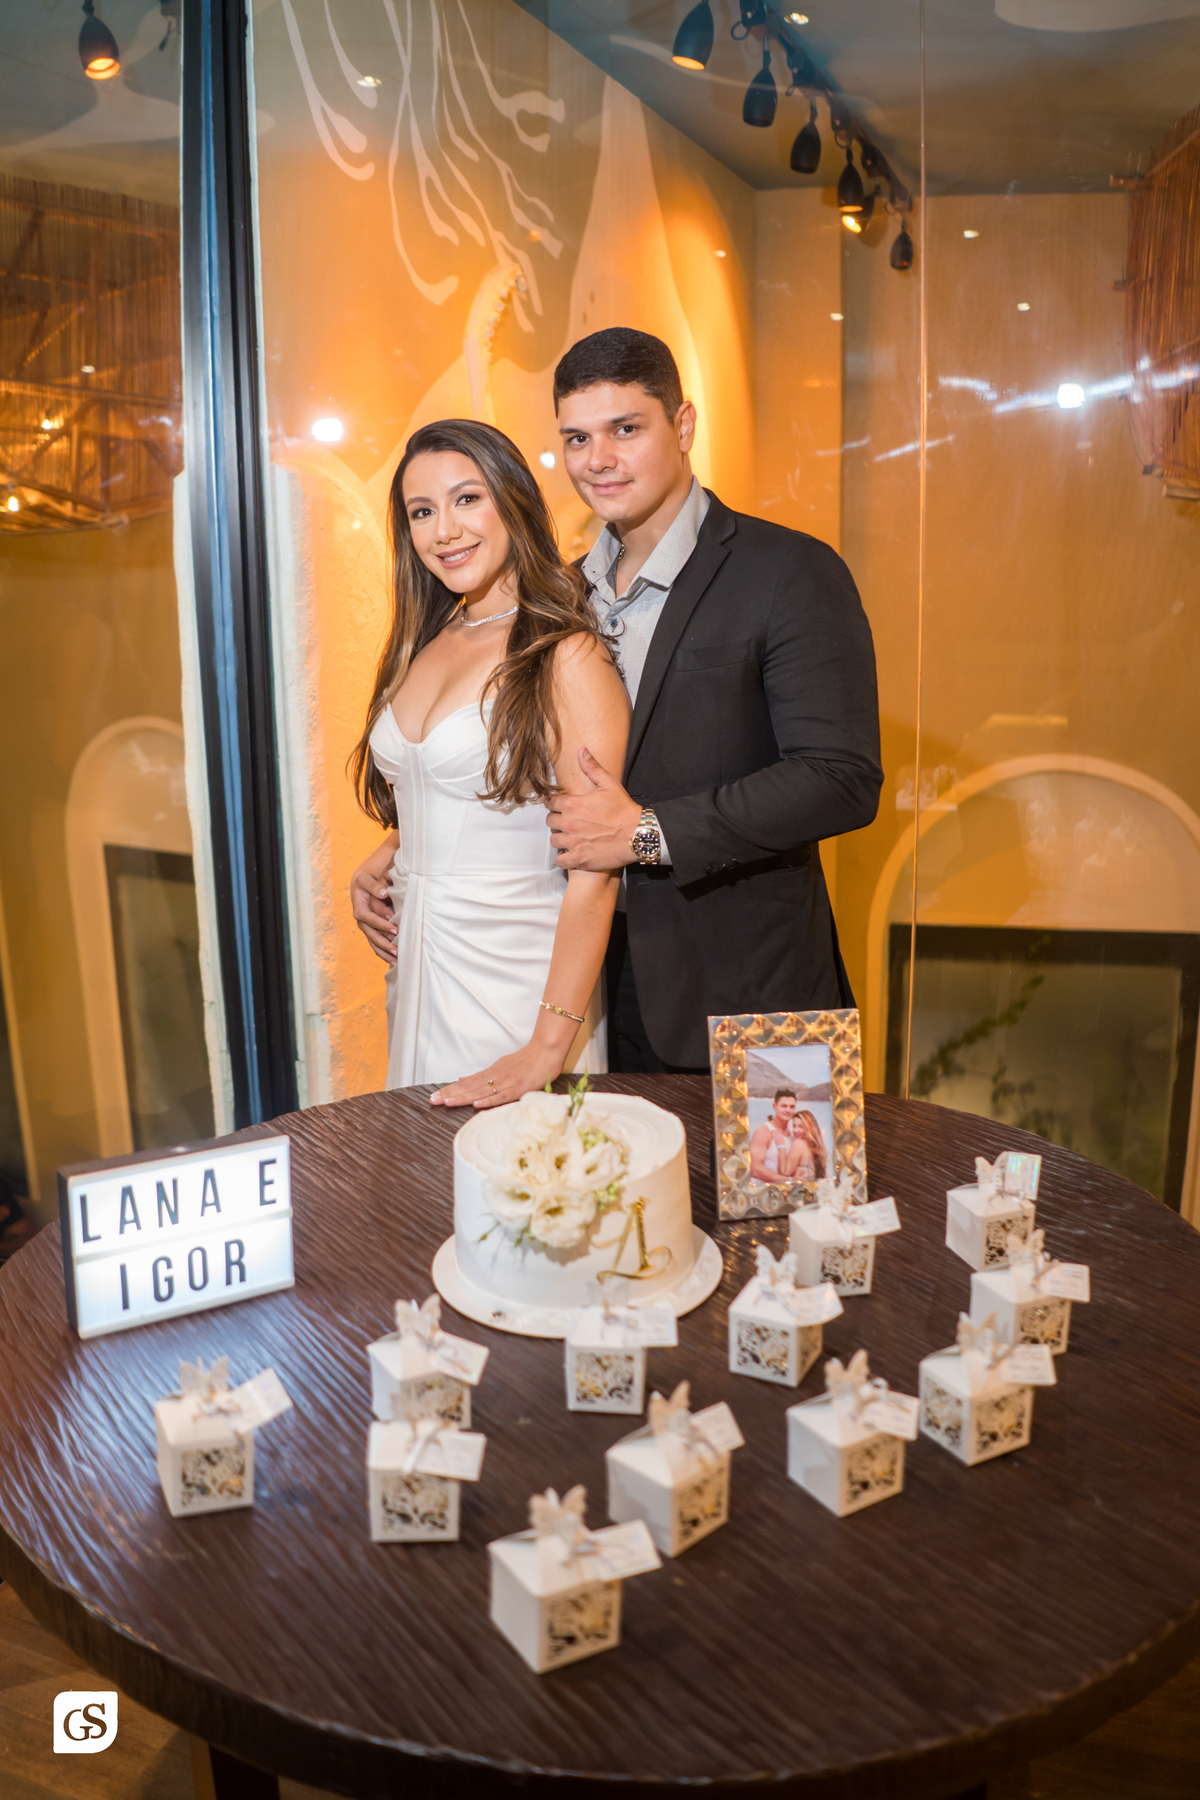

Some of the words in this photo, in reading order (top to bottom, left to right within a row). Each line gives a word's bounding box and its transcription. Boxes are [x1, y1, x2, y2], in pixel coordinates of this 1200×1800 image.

[79, 1168, 222, 1243] LANA
[258, 1157, 278, 1207] E
[119, 1238, 247, 1311] IGOR
